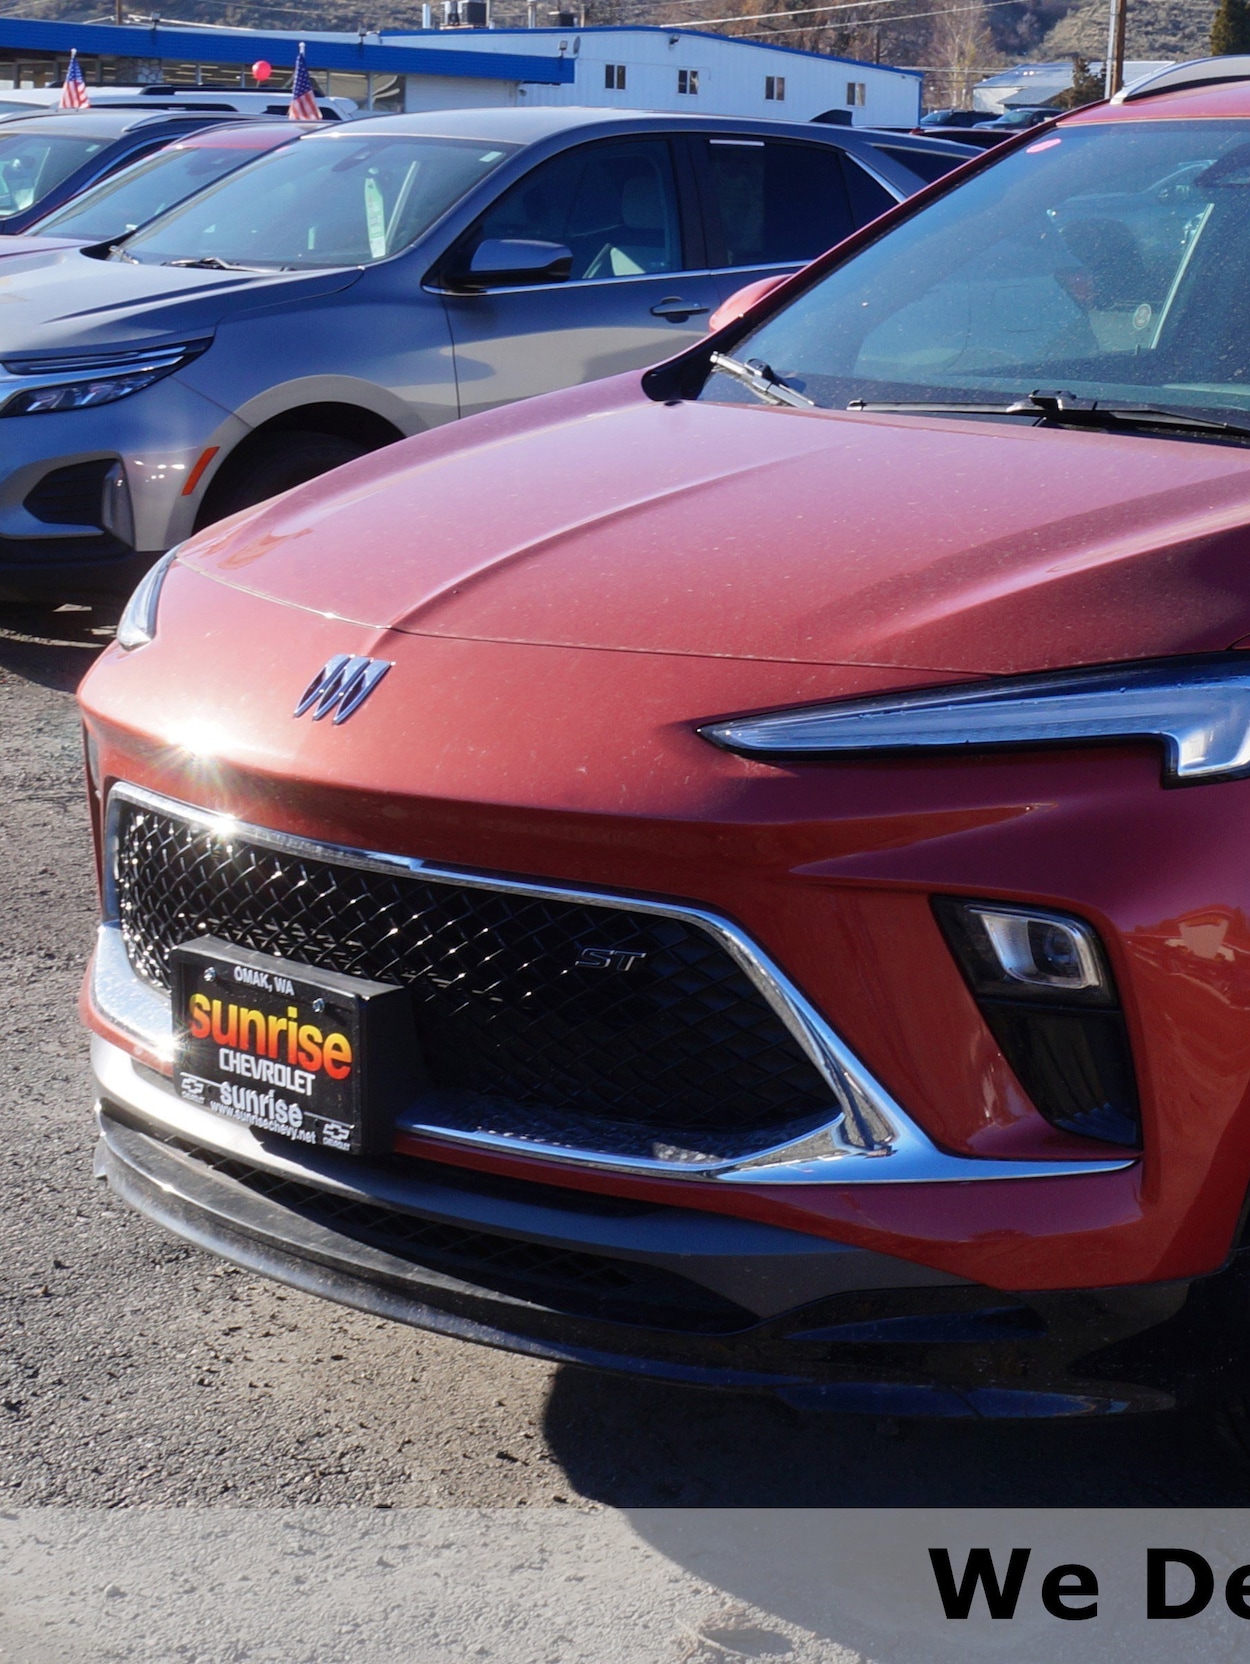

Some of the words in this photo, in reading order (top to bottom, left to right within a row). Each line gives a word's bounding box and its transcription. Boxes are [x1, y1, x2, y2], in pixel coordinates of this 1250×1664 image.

[233, 965, 273, 993] OMAK,
[273, 976, 296, 996] WA
[575, 947, 647, 971] ST
[188, 992, 353, 1081] sunrise
[218, 1047, 317, 1096] CHEVROLET
[209, 1100, 317, 1145] www.sunrisechevy.net
[219, 1081, 304, 1127] sunrise
